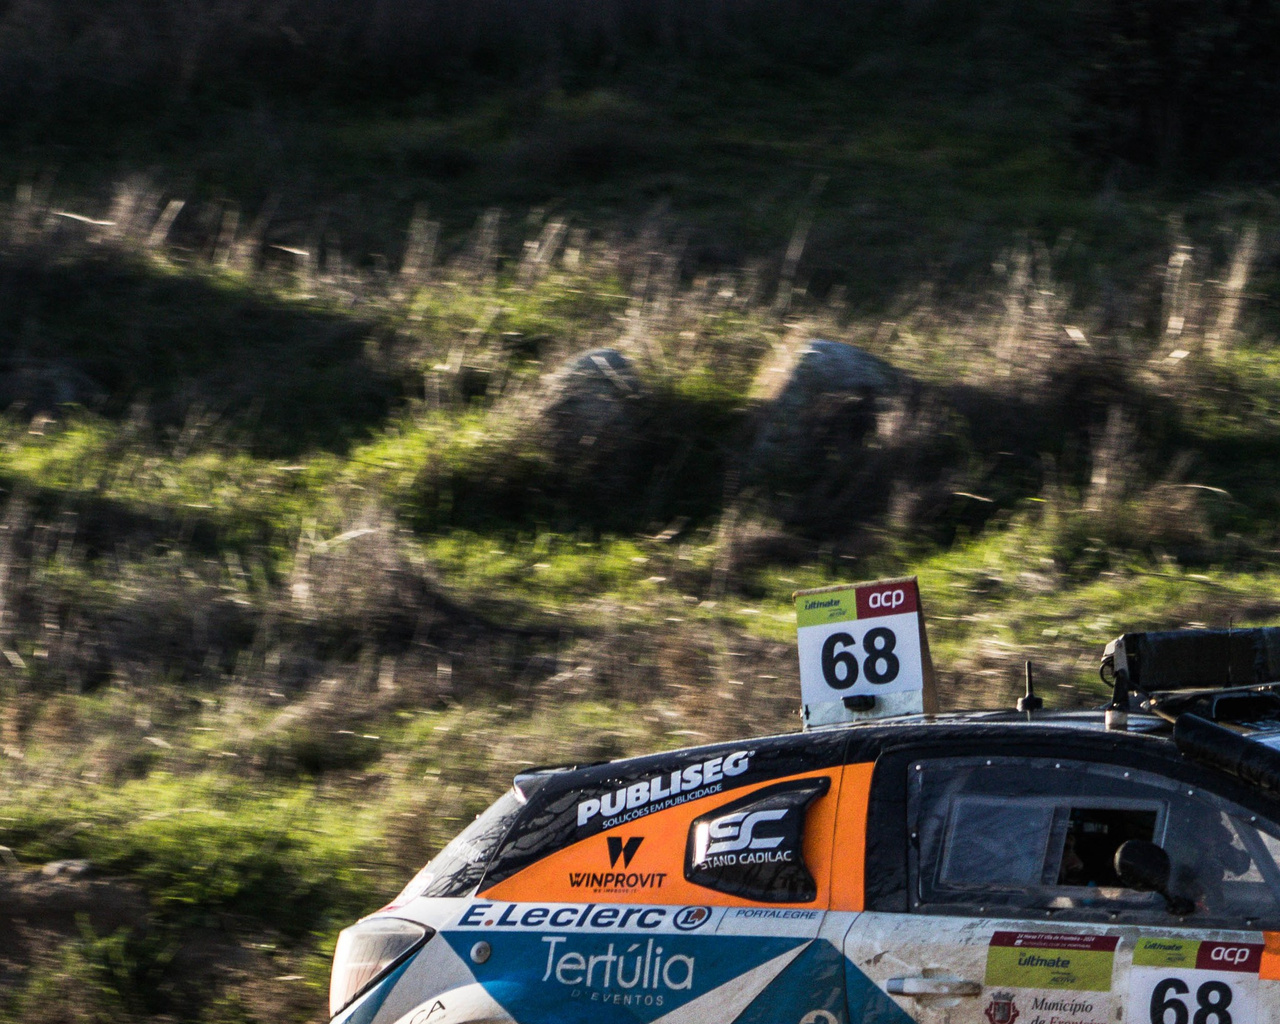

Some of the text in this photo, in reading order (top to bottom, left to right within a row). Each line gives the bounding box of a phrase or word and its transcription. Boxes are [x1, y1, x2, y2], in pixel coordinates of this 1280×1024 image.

[869, 589, 904, 608] acp
[821, 627, 899, 690] 68
[577, 751, 749, 827] PUBLISEG
[602, 783, 723, 829] SOLUÇÕES EM PUBLICIDADE
[700, 850, 792, 870] STAND CADILAC
[569, 873, 667, 888] WINPROVIT
[458, 903, 666, 928] E.Leclerc
[736, 909, 819, 920] PORTALEGRE
[541, 936, 695, 990] Tertúlia
[1018, 955, 1070, 968] ultimate
[1210, 946, 1250, 965] acp
[1031, 997, 1093, 1016] Município
